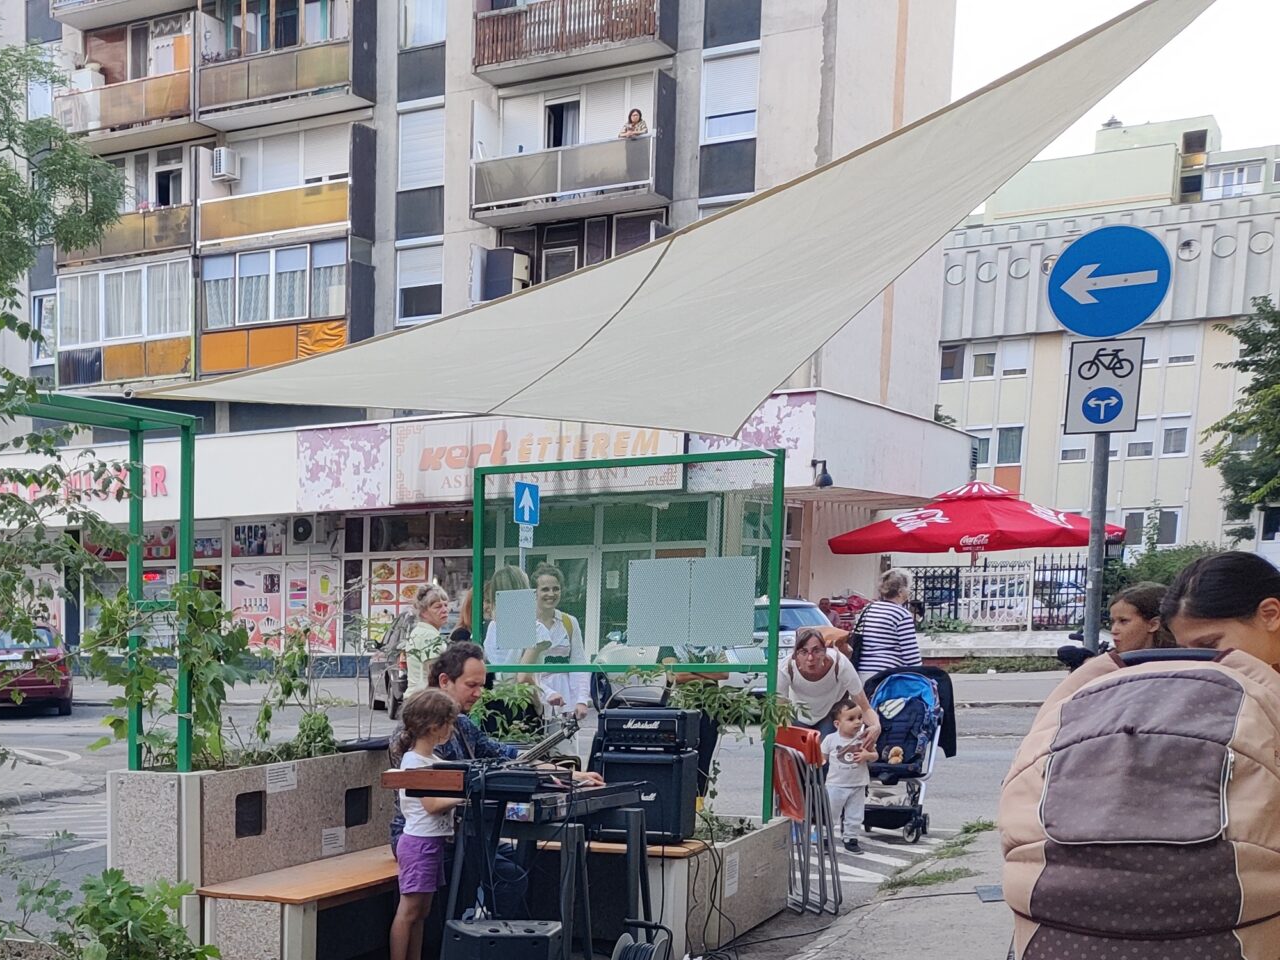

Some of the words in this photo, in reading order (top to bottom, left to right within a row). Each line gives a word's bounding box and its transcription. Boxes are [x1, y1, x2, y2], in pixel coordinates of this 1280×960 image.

[517, 429, 661, 463] ÉTTEREM
[440, 472, 497, 489] ASIN
[622, 719, 661, 729] Marshall
